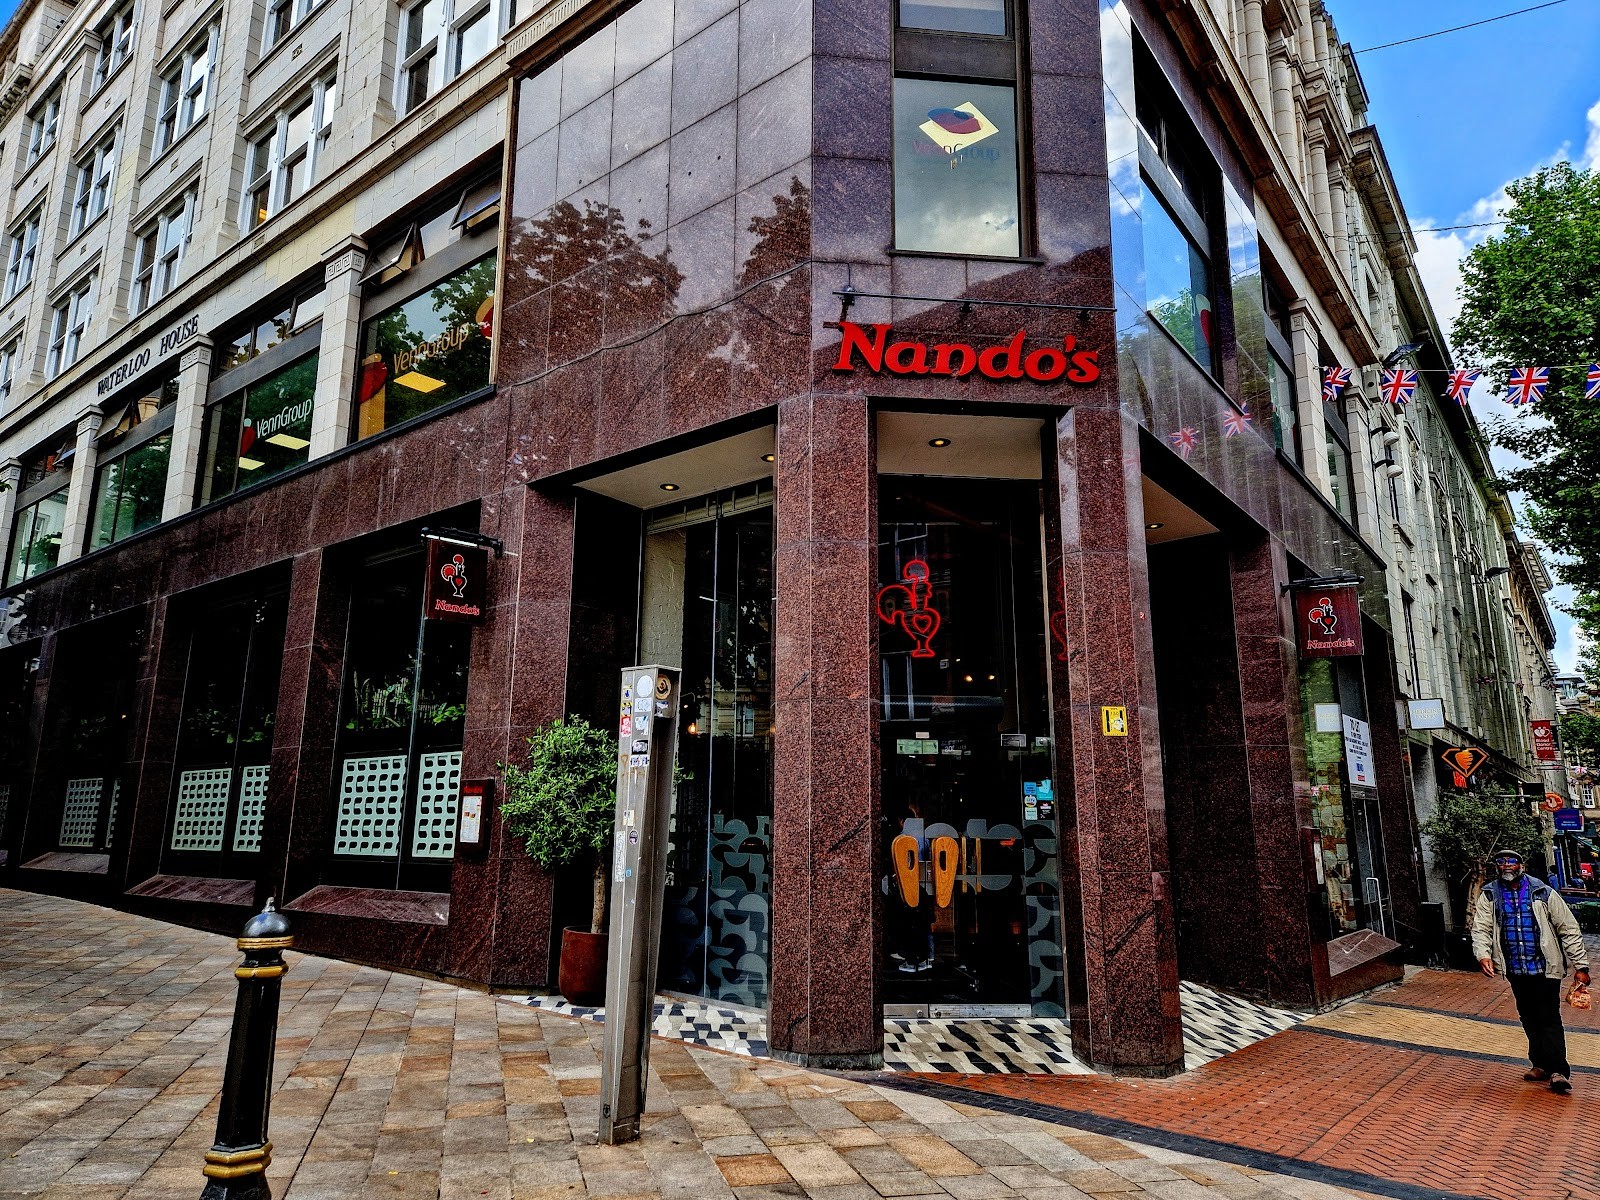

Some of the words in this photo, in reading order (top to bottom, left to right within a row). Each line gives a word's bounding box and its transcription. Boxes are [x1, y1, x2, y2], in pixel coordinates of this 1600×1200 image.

[97, 348, 150, 397] WATERLOO
[159, 314, 199, 356] HOUSE
[832, 321, 1100, 384] Nando's
[257, 399, 312, 439] VennGroup
[435, 599, 480, 616] Nando's
[1307, 638, 1355, 650] Nando's
